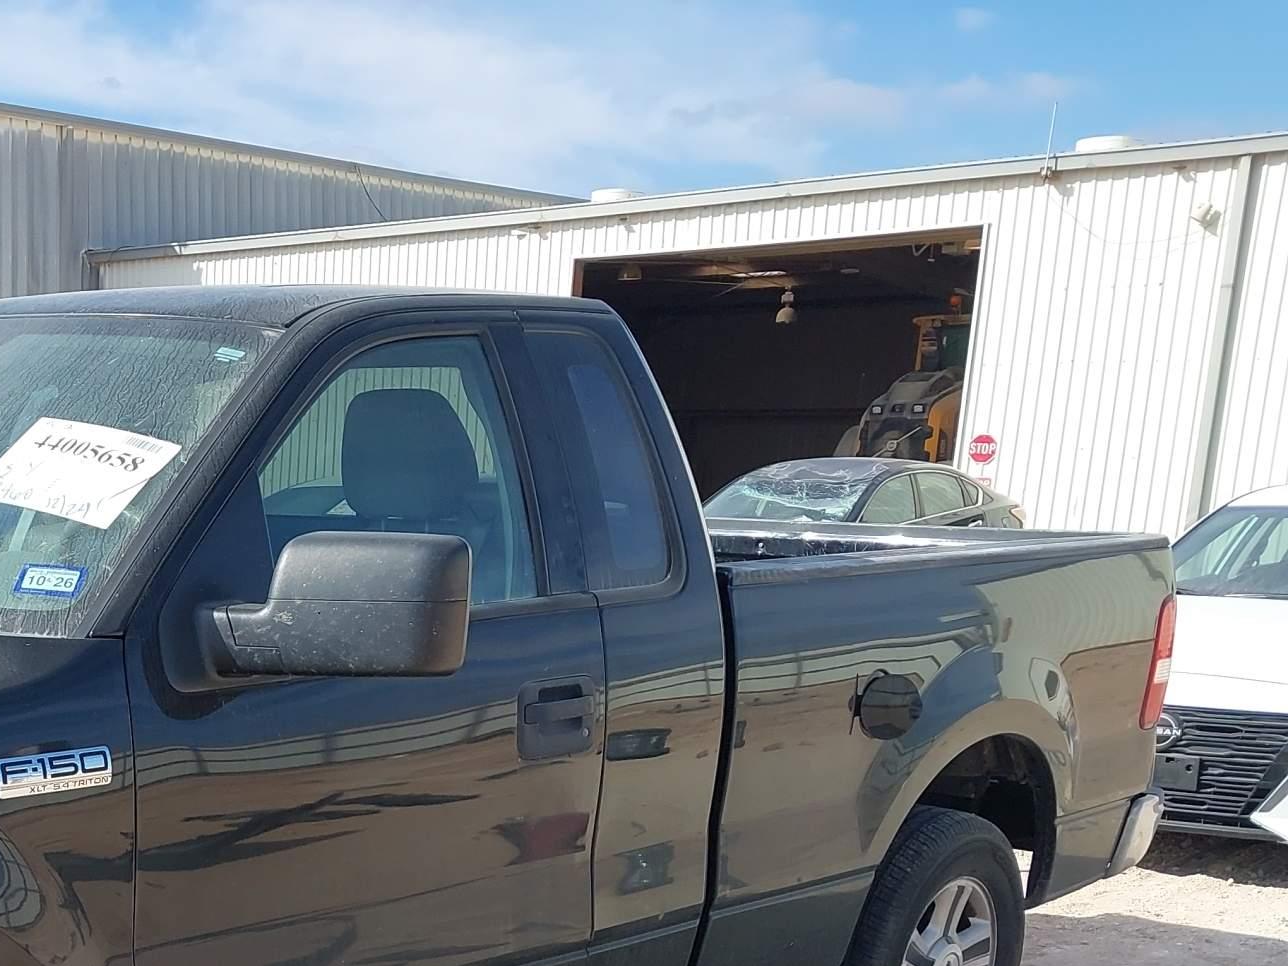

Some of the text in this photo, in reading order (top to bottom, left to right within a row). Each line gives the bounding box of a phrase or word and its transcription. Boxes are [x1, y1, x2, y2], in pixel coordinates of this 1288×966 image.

[34, 435, 145, 472] 44005658
[969, 442, 997, 455] STOP
[28, 575, 74, 588] 10 26
[0, 751, 108, 784] F-150
[29, 784, 48, 794] XLT
[74, 776, 109, 788] TRITON
